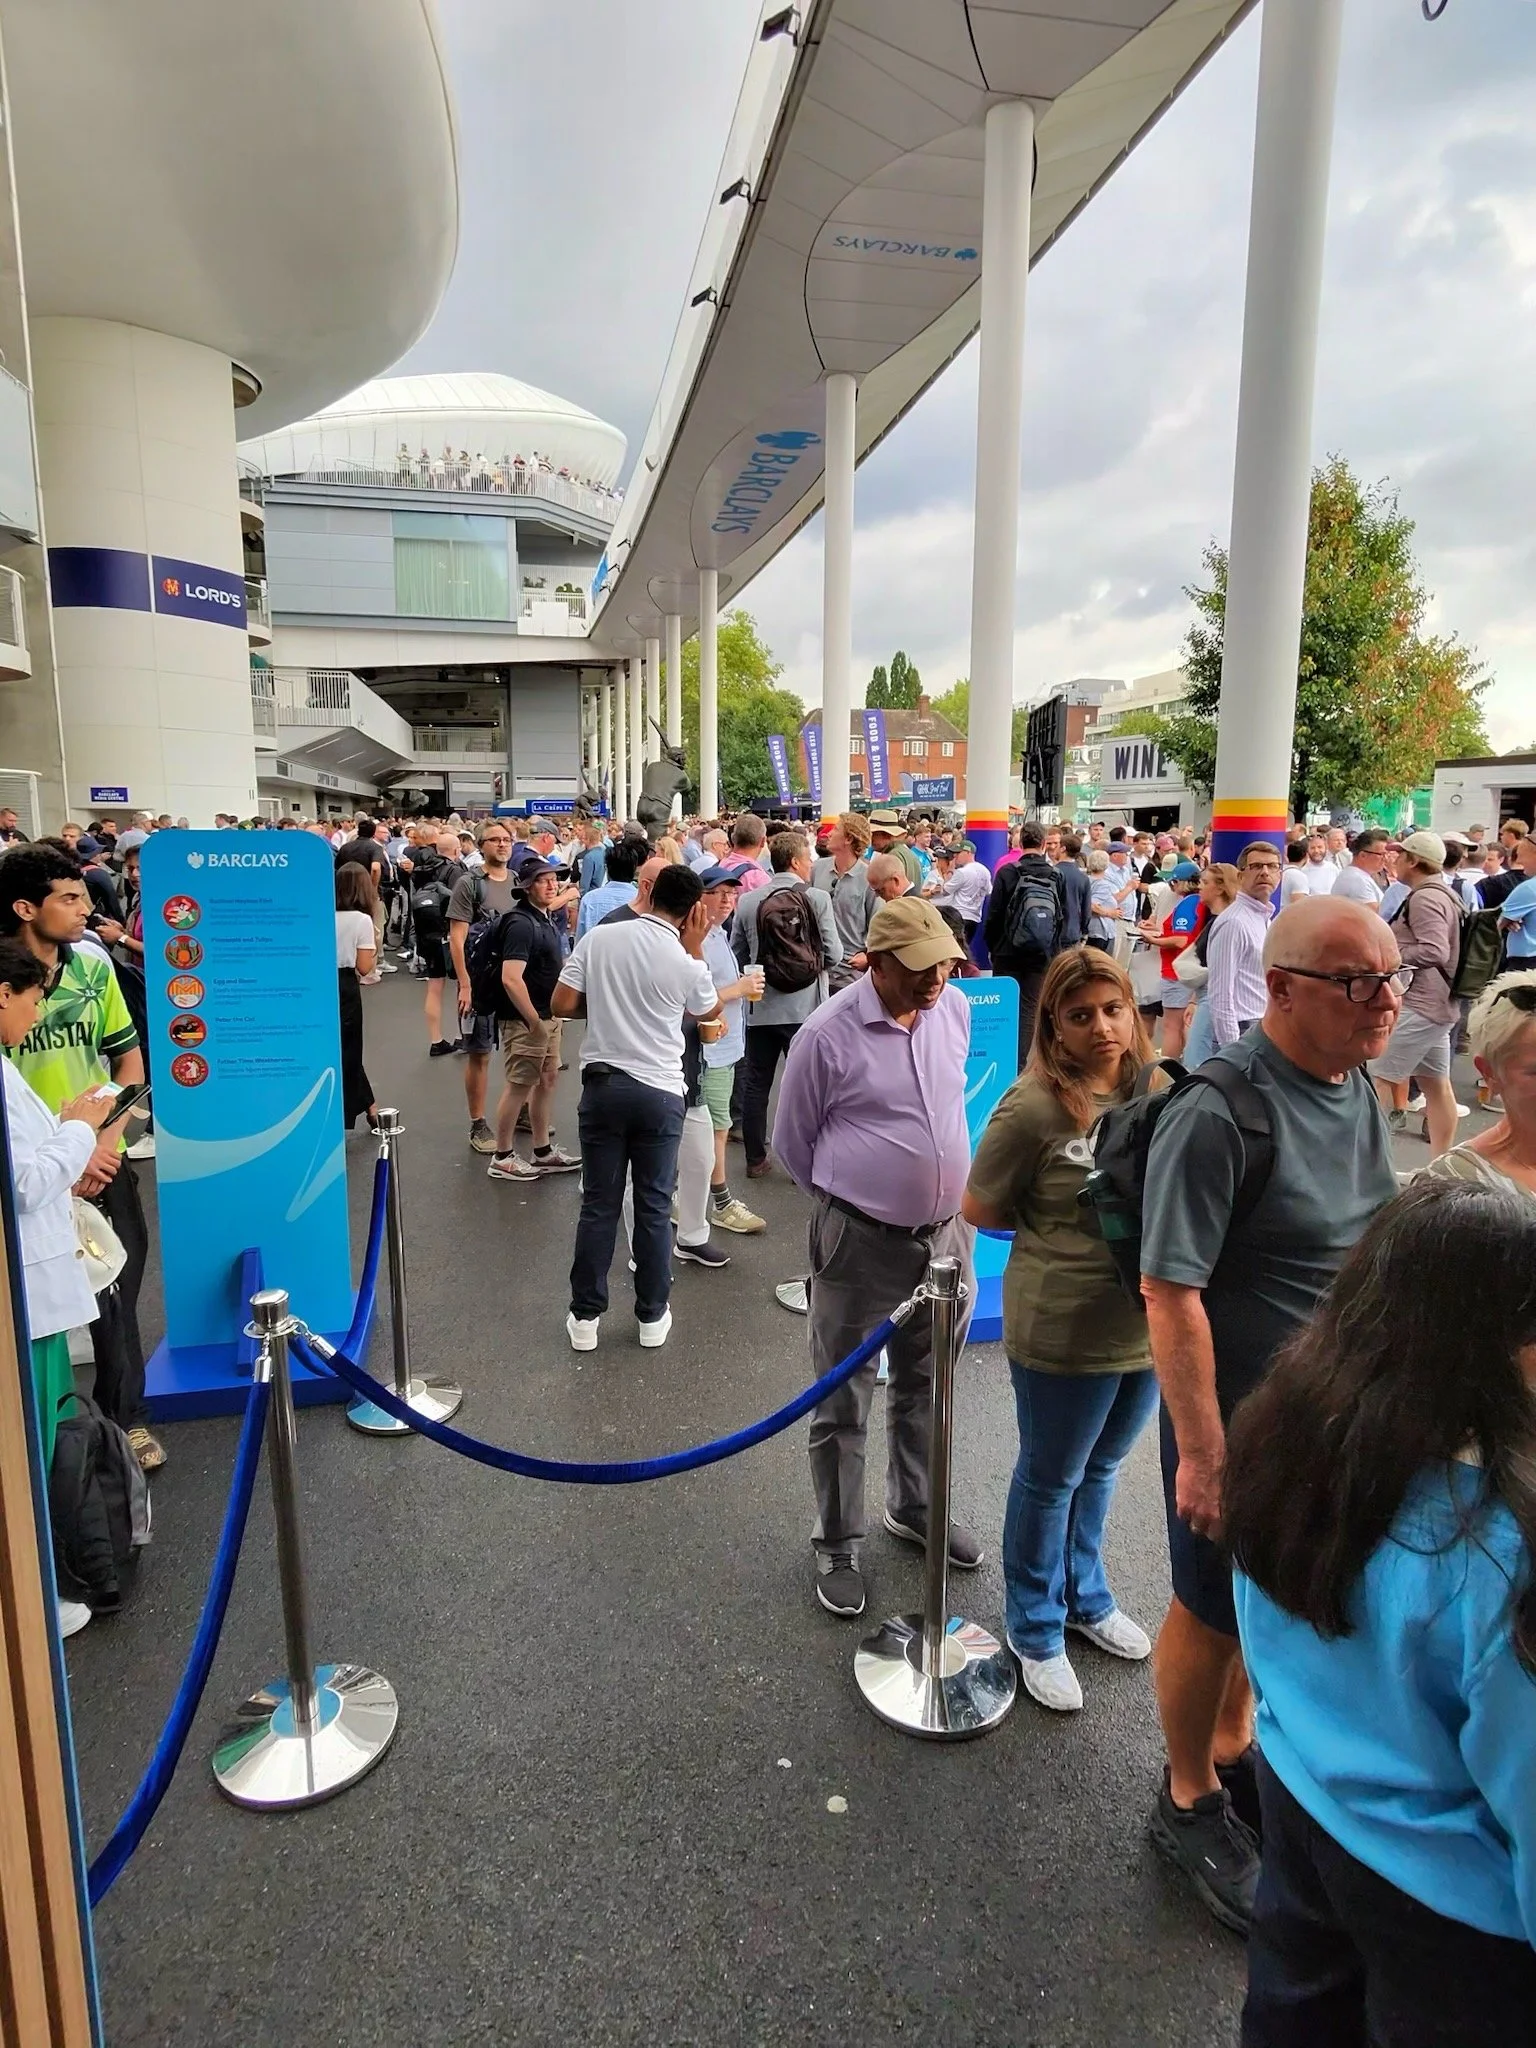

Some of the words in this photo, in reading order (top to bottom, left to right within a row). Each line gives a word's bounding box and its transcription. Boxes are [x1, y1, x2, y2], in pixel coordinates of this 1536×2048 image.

[833, 235, 951, 258] BARCLAYS
[711, 452, 800, 534] BARCLAYS
[185, 583, 242, 608] LORD'S
[867, 716, 879, 742] FOOD
[772, 740, 782, 760] FOOD
[778, 769, 788, 792] DRINK
[872, 755, 883, 785] DRINK
[1115, 744, 1168, 780] WINE
[207, 853, 289, 868] BARCLAYS
[968, 994, 1000, 1005] RCLAYS
